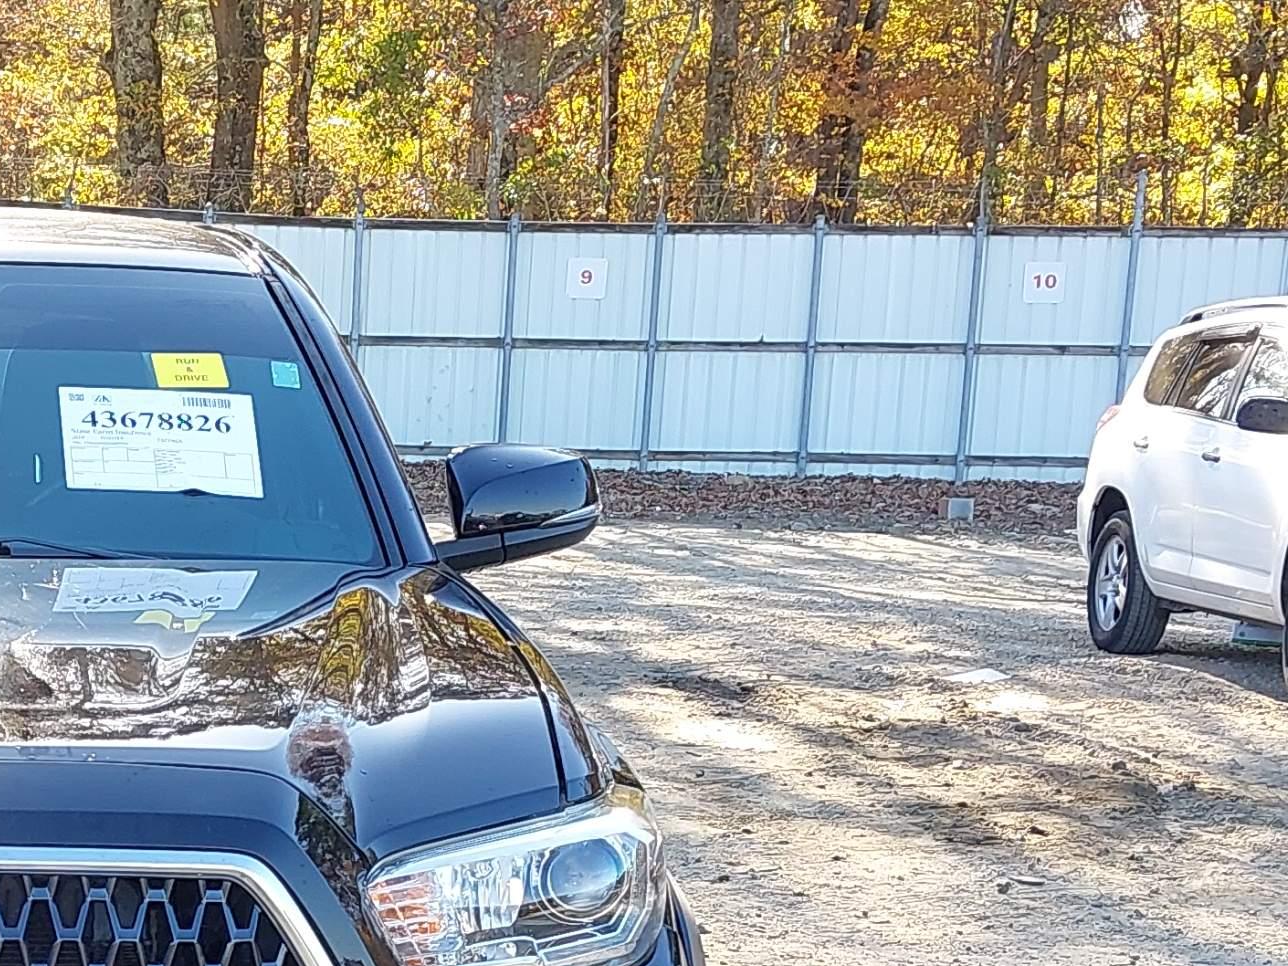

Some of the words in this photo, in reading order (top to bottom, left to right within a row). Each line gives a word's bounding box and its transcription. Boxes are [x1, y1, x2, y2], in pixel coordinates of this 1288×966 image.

[580, 269, 593, 285] 9
[1033, 273, 1057, 289] 10
[174, 374, 209, 382] DRIVE
[81, 410, 232, 434] 43678826
